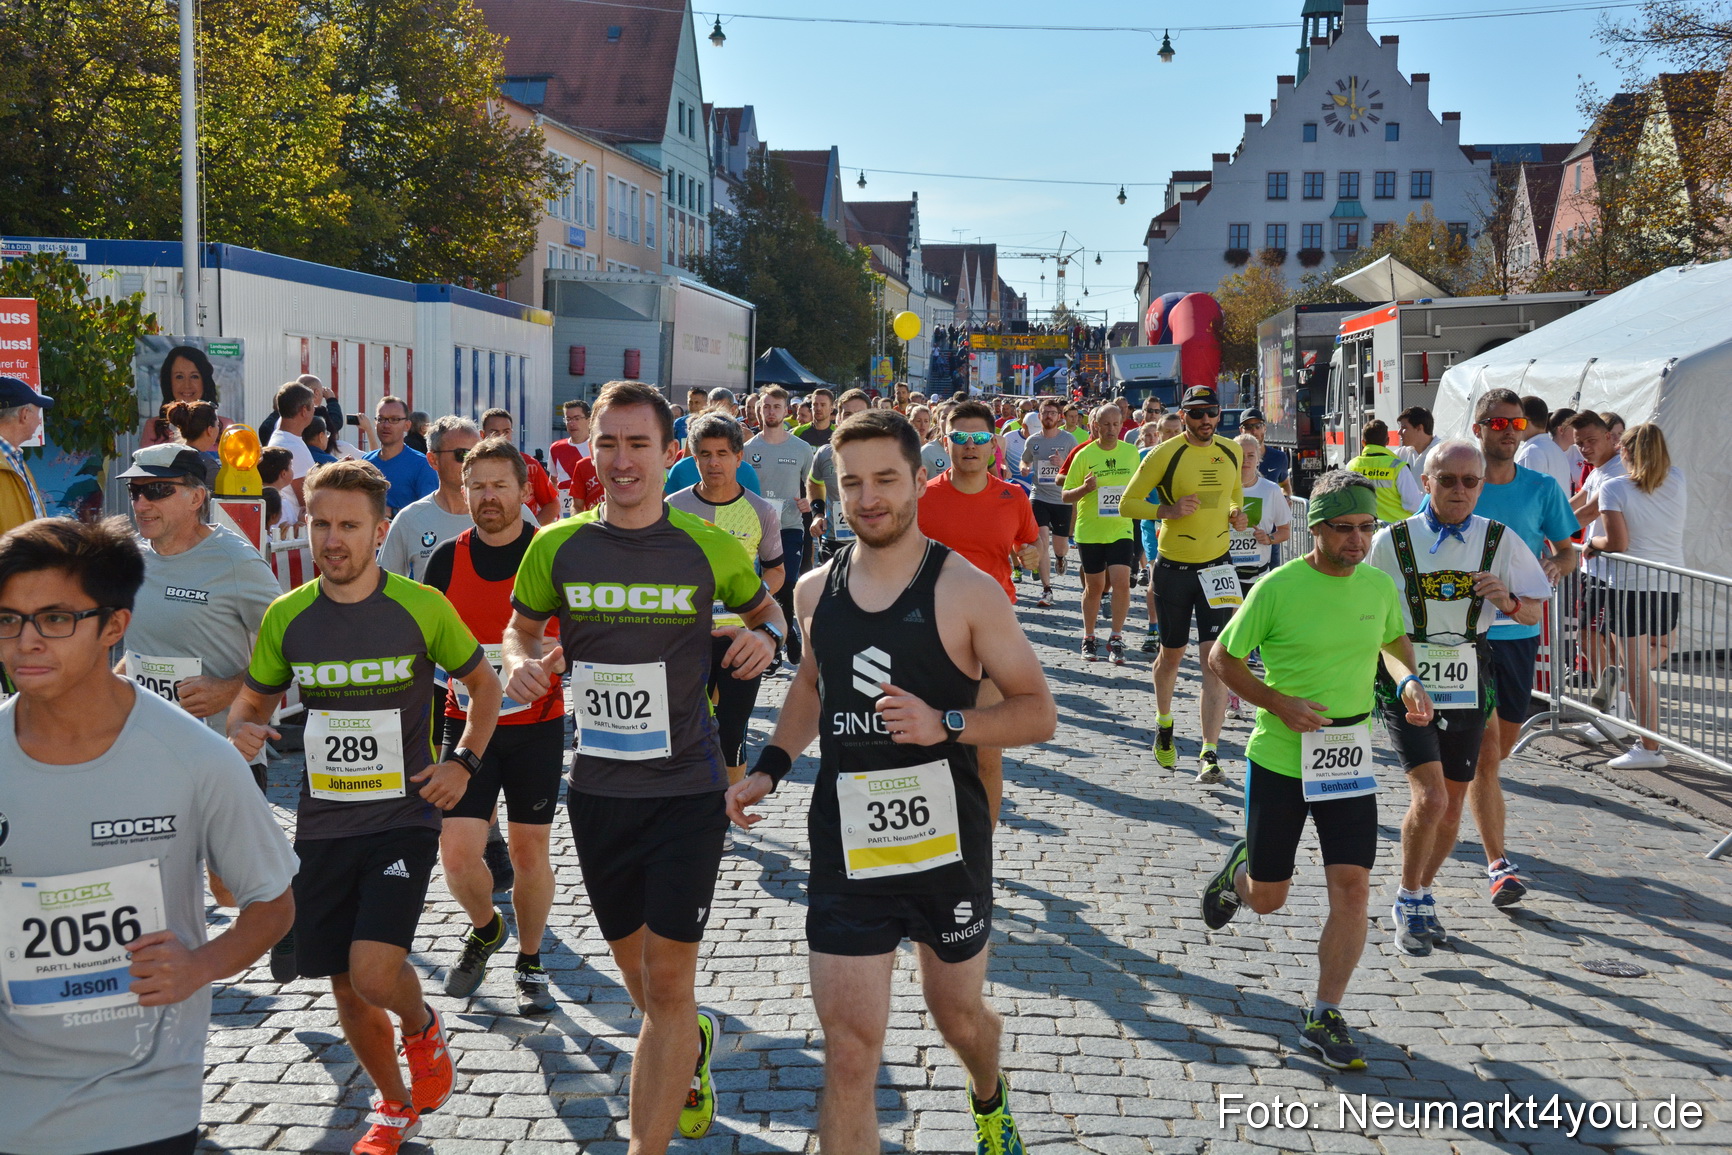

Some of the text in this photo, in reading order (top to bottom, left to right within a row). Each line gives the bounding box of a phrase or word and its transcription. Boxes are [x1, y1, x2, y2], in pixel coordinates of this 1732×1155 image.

[1001, 336, 1037, 346] START
[16, 359, 28, 368] für
[1041, 467, 1060, 475] 2379
[1362, 469, 1389, 477] Leiter
[1103, 494, 1122, 505] 229
[1230, 538, 1257, 550] 2262
[1212, 577, 1235, 591] 205
[165, 586, 209, 601] BOCK
[565, 583, 697, 613] BOCK
[603, 614, 616, 625] by
[618, 615, 650, 624] smart
[653, 615, 697, 626] concepts
[142, 661, 176, 673] BOCK
[291, 656, 415, 687] BOCK
[1418, 662, 1468, 682] 2140
[594, 672, 635, 683] BOCK
[328, 689, 341, 698] by
[344, 687, 374, 697] smart
[377, 680, 414, 695] concepts
[1434, 693, 1452, 702] Willi
[585, 689, 652, 720] 3102
[329, 718, 371, 729] BOCK
[594, 721, 611, 729] PARTL
[1325, 733, 1355, 742] BOCK
[325, 736, 378, 762] 289
[1312, 746, 1363, 769] 2580
[345, 765, 374, 773] Neumarkt
[328, 778, 382, 790] Johannes
[869, 776, 920, 792] BOCK
[1321, 780, 1359, 792] Benhard
[867, 796, 930, 832] 336
[91, 816, 176, 840] BOCK
[92, 839, 118, 847] inspired
[130, 836, 149, 844] smart
[868, 831, 926, 844] PARTL Neumarkt
[384, 869, 410, 879] adidas
[39, 882, 113, 906] BOCK
[22, 905, 142, 959] 2056
[941, 918, 985, 943] SINGER
[36, 955, 122, 974] PARTL Neumarkt
[60, 977, 118, 998] Jason
[63, 1005, 144, 1028] Stadtlauf
